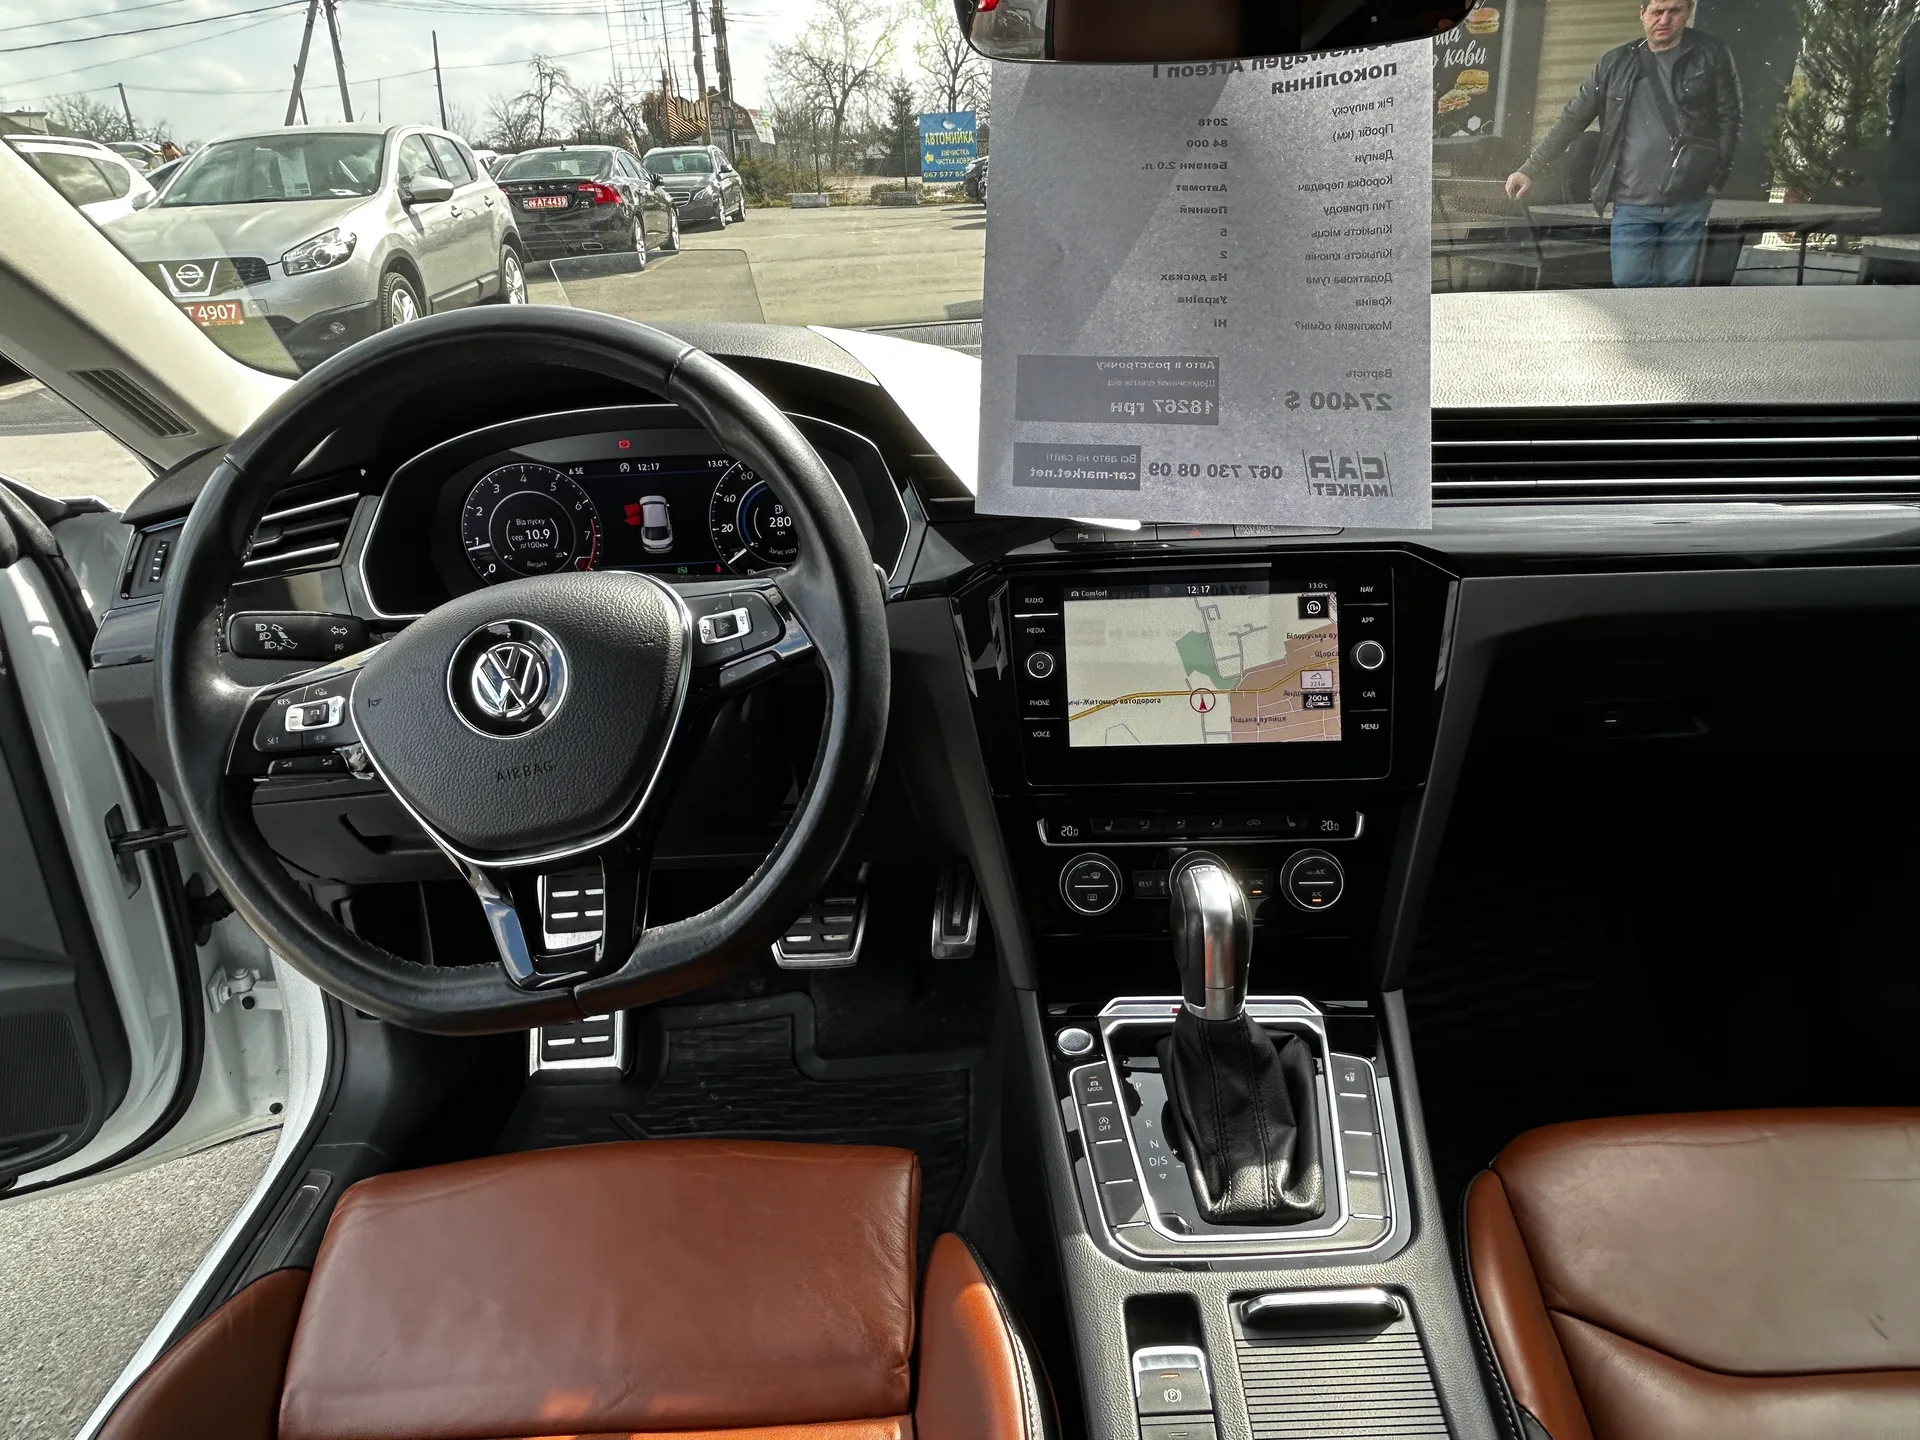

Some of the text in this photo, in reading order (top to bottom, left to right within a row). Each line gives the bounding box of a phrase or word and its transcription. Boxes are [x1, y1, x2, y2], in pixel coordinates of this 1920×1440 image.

[925, 128, 974, 145] АВТОМИЙКА
[198, 304, 236, 320] 4907
[638, 463, 660, 472] 12:17
[520, 475, 527, 483] 4
[741, 471, 754, 480] 60
[493, 484, 500, 493] 3
[550, 482, 557, 491] 5
[723, 494, 736, 503] 40
[575, 501, 582, 511] 6
[476, 507, 483, 516] 2
[768, 516, 792, 528] 280
[721, 524, 734, 533] 20
[525, 529, 550, 540] 10.9
[584, 530, 591, 540] 7
[489, 564, 496, 573] 0
[1081, 590, 1108, 598] Comfort
[1187, 585, 1210, 595] 12:17
[277, 698, 291, 706] RES
[267, 737, 280, 745] SET
[497, 761, 554, 783] AIRBAG
[1320, 820, 1340, 832] 20.0
[1060, 825, 1079, 837] 20.0
[1135, 1082, 1142, 1091] P
[1145, 1120, 1153, 1128] R
[1149, 1140, 1159, 1149] N
[1148, 1156, 1168, 1167] D/S
